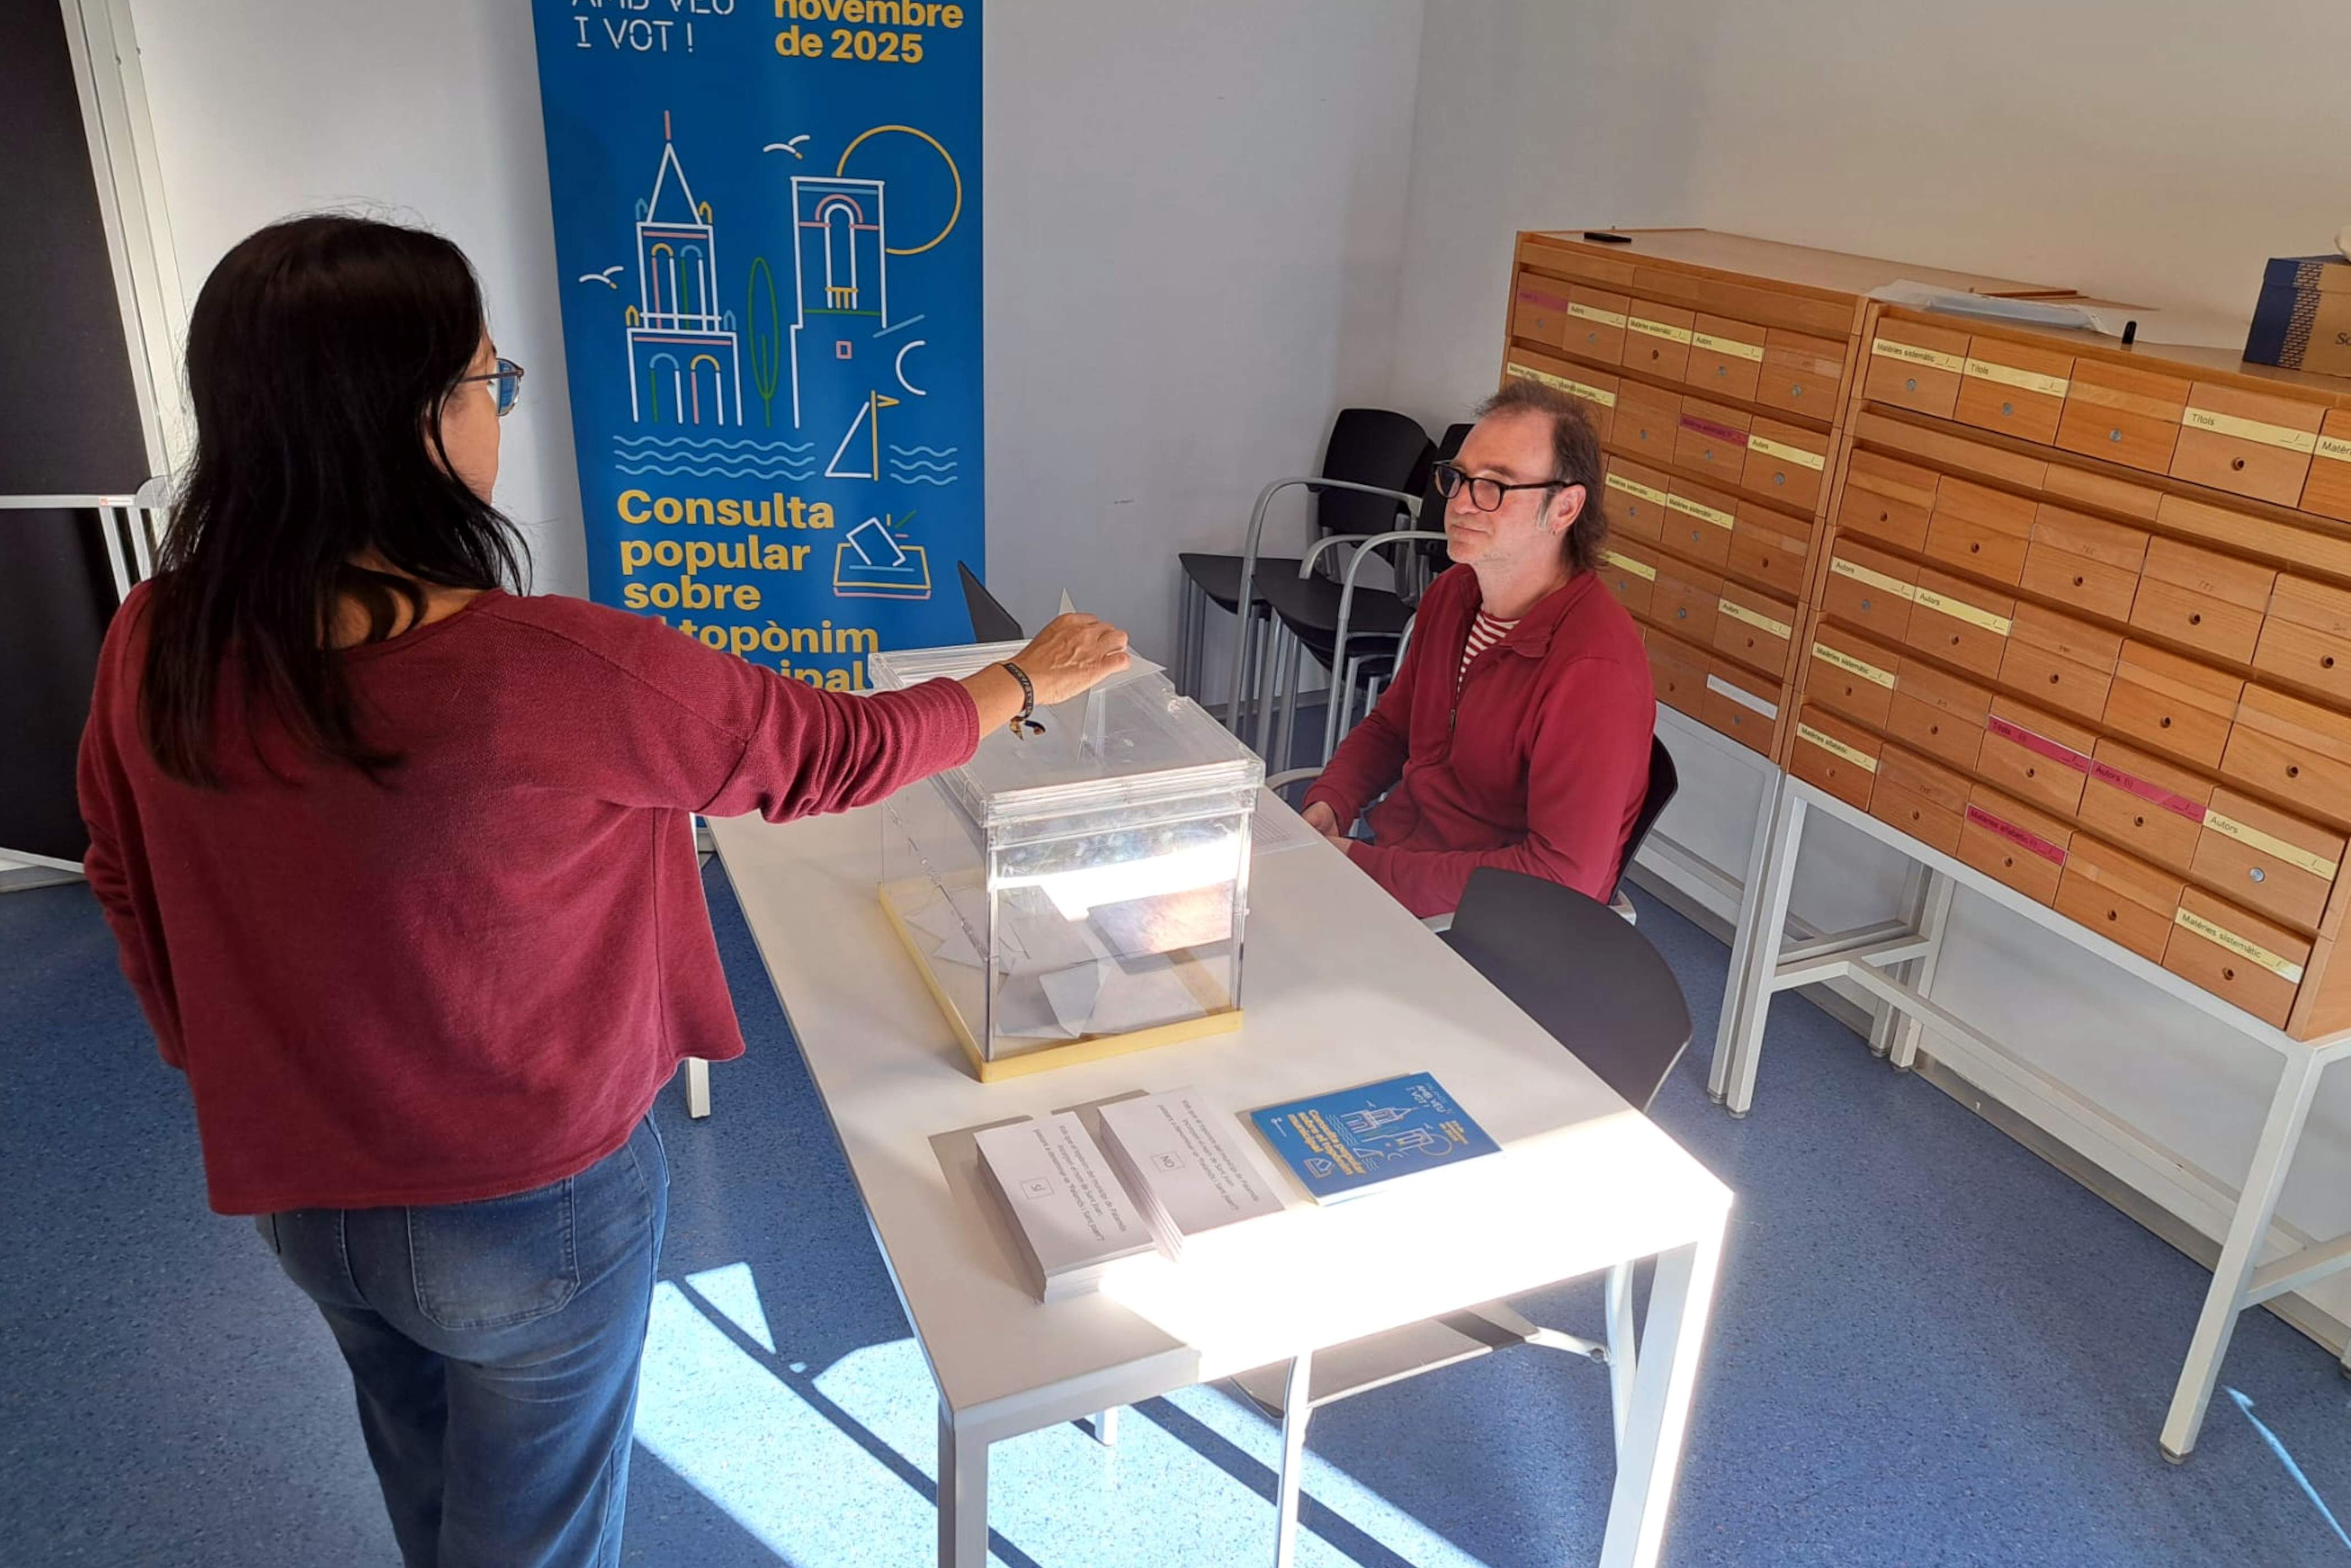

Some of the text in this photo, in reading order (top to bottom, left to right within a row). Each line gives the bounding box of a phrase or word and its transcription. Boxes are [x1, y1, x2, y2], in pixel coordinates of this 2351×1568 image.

[774, 0, 964, 28] novembre
[574, 17, 592, 47] I
[603, 18, 674, 52] VOT
[775, 25, 923, 63] de 2025
[617, 489, 835, 529] Consulta
[620, 534, 811, 575] popular
[624, 575, 762, 610] sobre
[1920, 592, 1940, 605] Autors
[679, 616, 878, 655] topònim
[2096, 766, 2121, 783] Autors
[2210, 817, 2238, 834] Autors
[1160, 1155, 1176, 1168] NO
